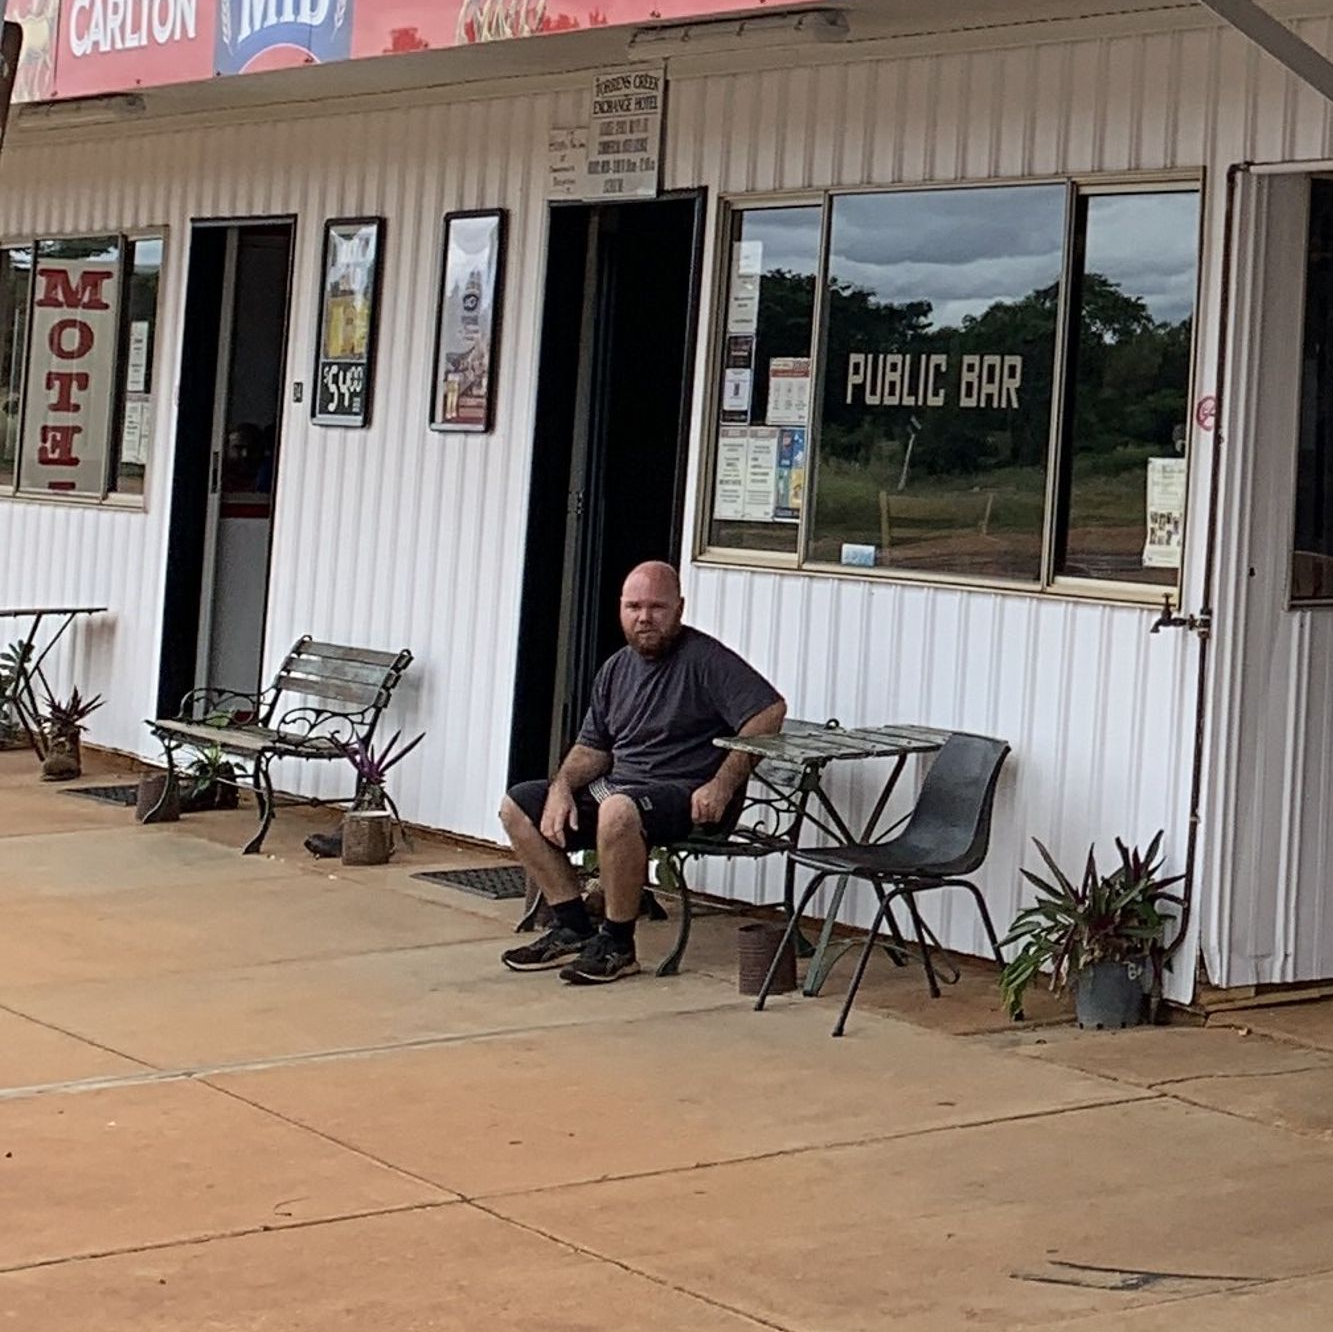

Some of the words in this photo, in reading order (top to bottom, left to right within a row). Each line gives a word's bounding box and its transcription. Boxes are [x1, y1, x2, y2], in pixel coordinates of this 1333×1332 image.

[36, 268, 113, 490] MOTE
[846, 352, 947, 406] PUBLIC
[959, 354, 1023, 409] BAR
